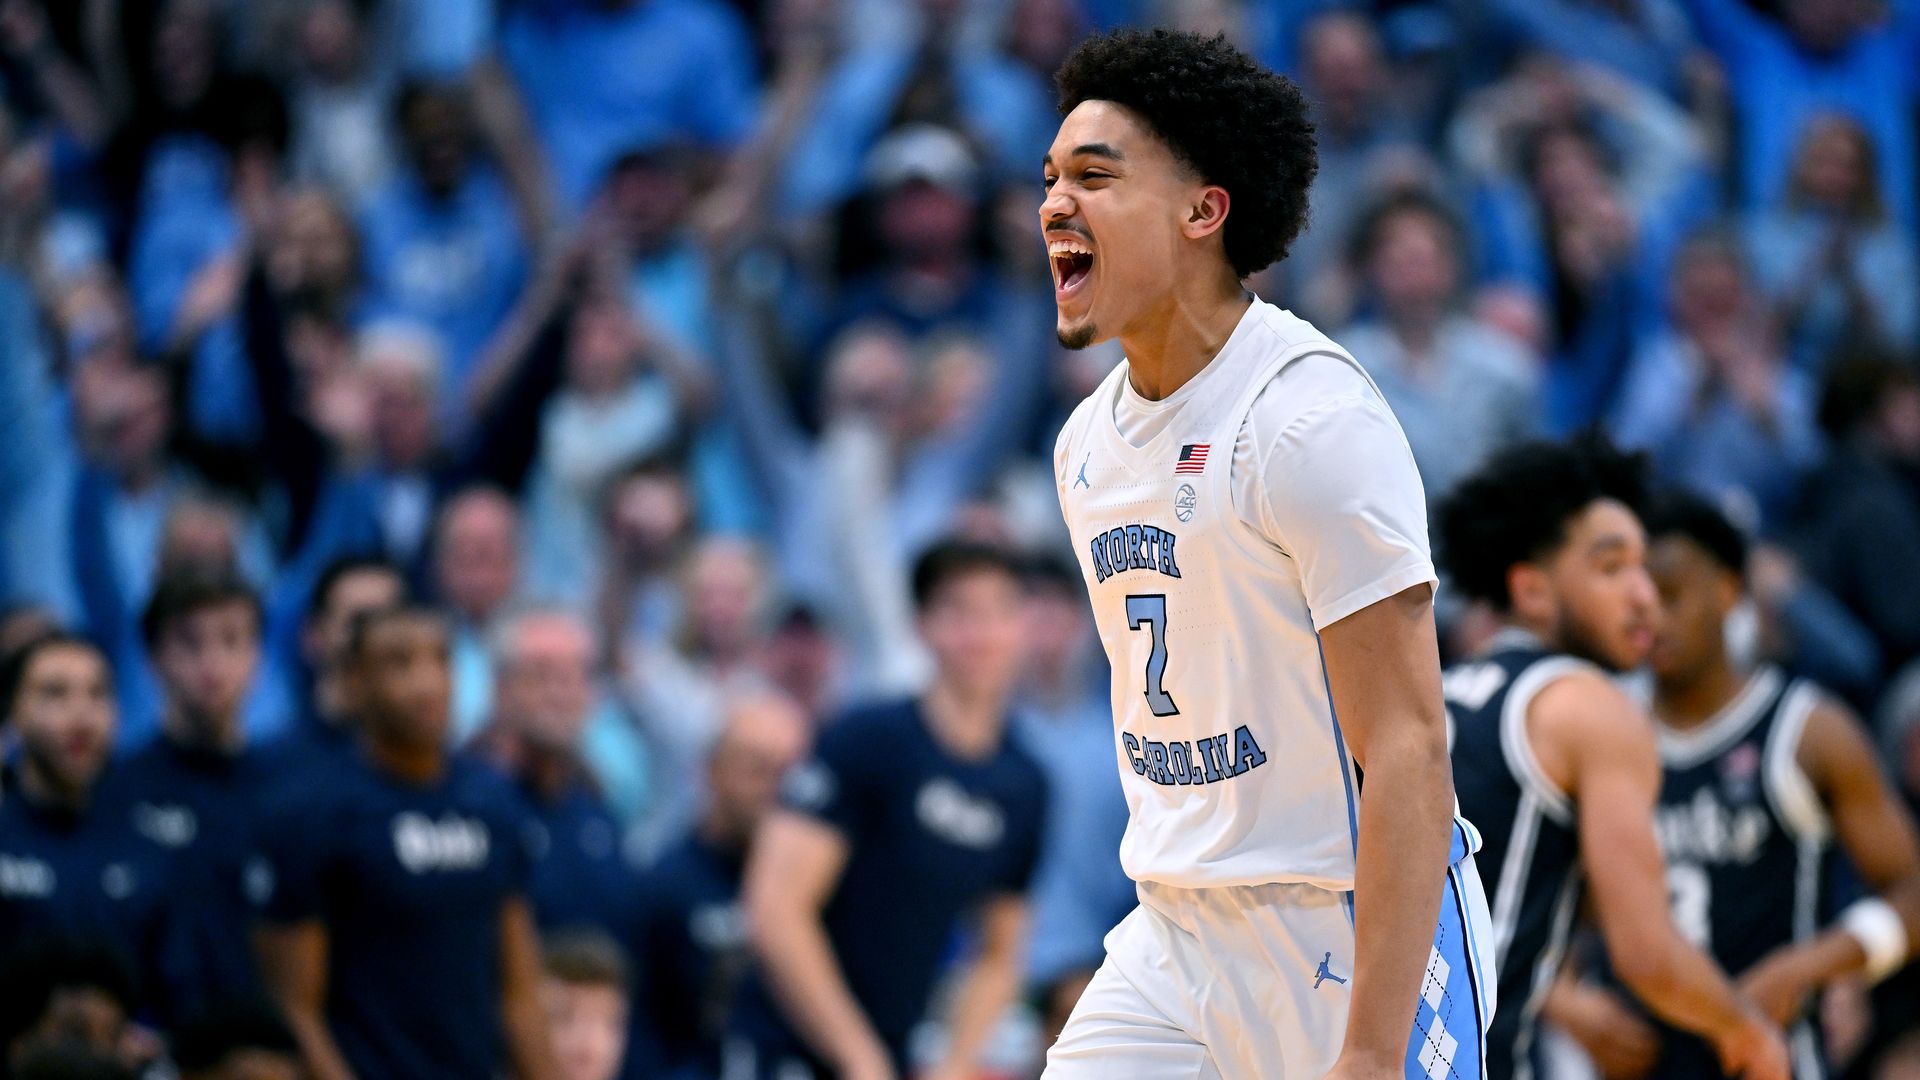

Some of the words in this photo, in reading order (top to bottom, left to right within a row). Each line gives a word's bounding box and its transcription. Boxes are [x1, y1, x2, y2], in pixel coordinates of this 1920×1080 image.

[1178, 496, 1196, 506] ACC
[1091, 524, 1181, 584] NORTH
[1126, 593, 1180, 717] 7
[1122, 724, 1267, 785] CAROLINA
